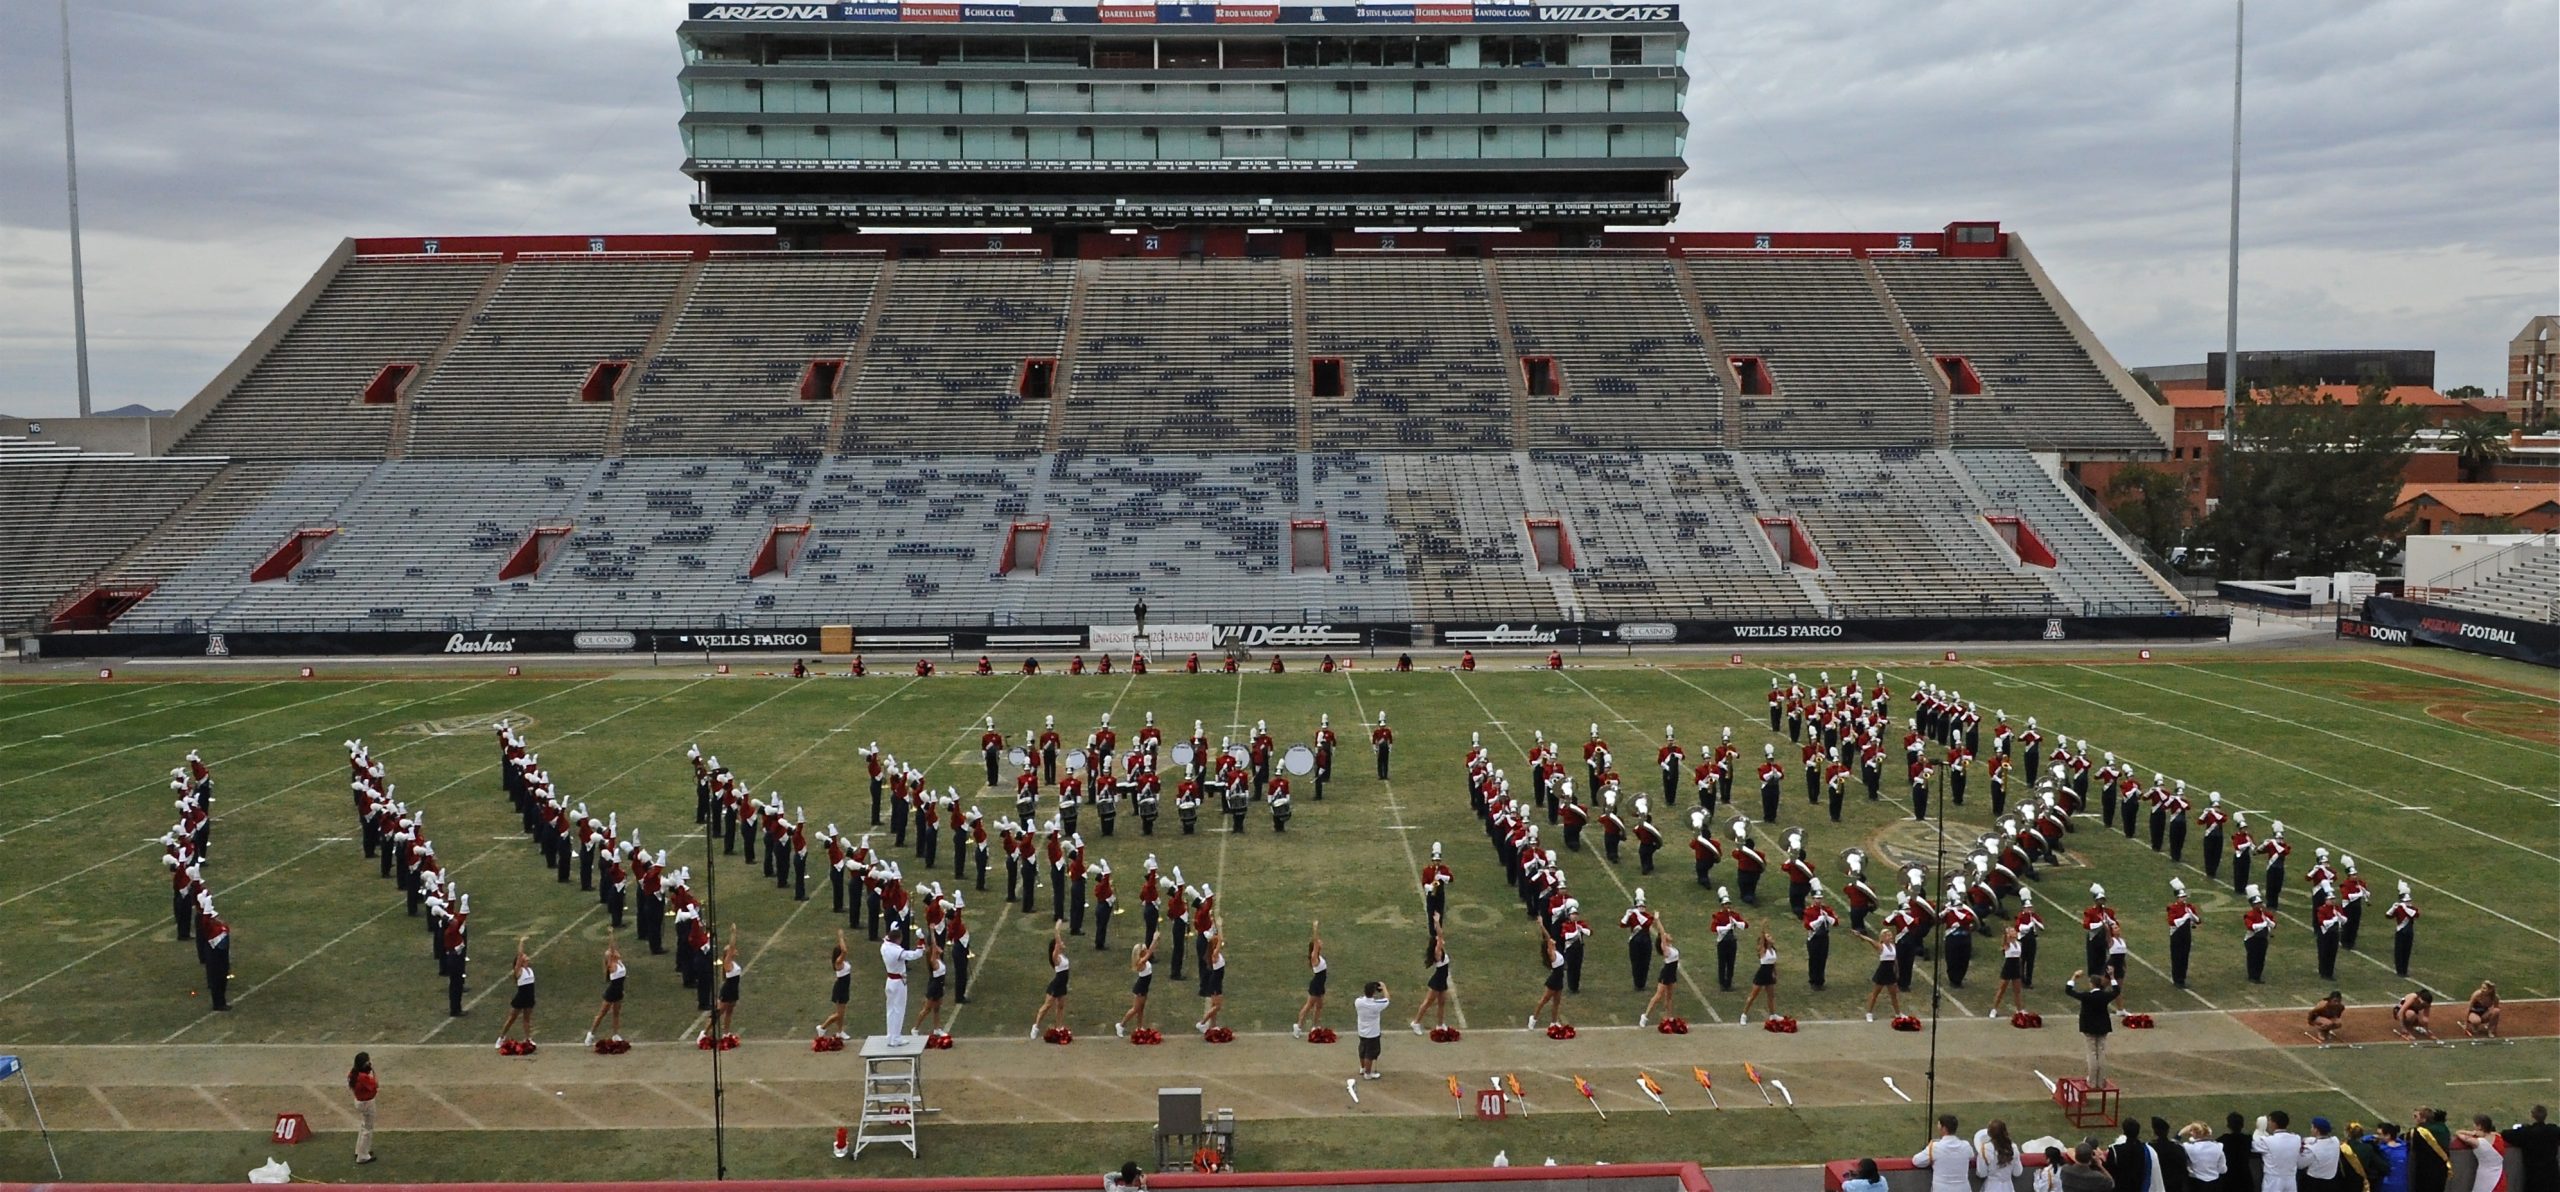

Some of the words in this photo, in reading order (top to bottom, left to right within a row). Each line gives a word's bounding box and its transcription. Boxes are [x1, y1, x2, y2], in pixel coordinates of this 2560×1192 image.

[703, 6, 828, 19] ARIZONA
[844, 7, 853, 15] 22
[971, 8, 994, 16] CHUCK
[996, 8, 1015, 16] CECIL
[1539, 7, 1671, 20] WILDCATS
[590, 243, 603, 252] 18
[779, 241, 790, 250] 19
[988, 240, 1002, 249] 20
[1146, 240, 1158, 249] 21
[1381, 240, 1395, 249] 22
[1588, 239, 1602, 248] 23
[1756, 240, 1769, 248] 24
[1898, 240, 1912, 249] 25
[426, 244, 437, 254] 17
[30, 423, 40, 432] 16
[1734, 626, 1787, 637] WELLS
[1790, 625, 1842, 637] FARGO
[694, 634, 750, 646] WELLS
[753, 634, 807, 646] FARGO
[1093, 632, 1129, 643] UNIVERSITY
[1174, 632, 1193, 642] BAND
[1195, 632, 1209, 642] DAY
[444, 633, 515, 652] Bashas'
[1481, 1094, 1501, 1116] 40
[275, 1117, 296, 1140] 40
